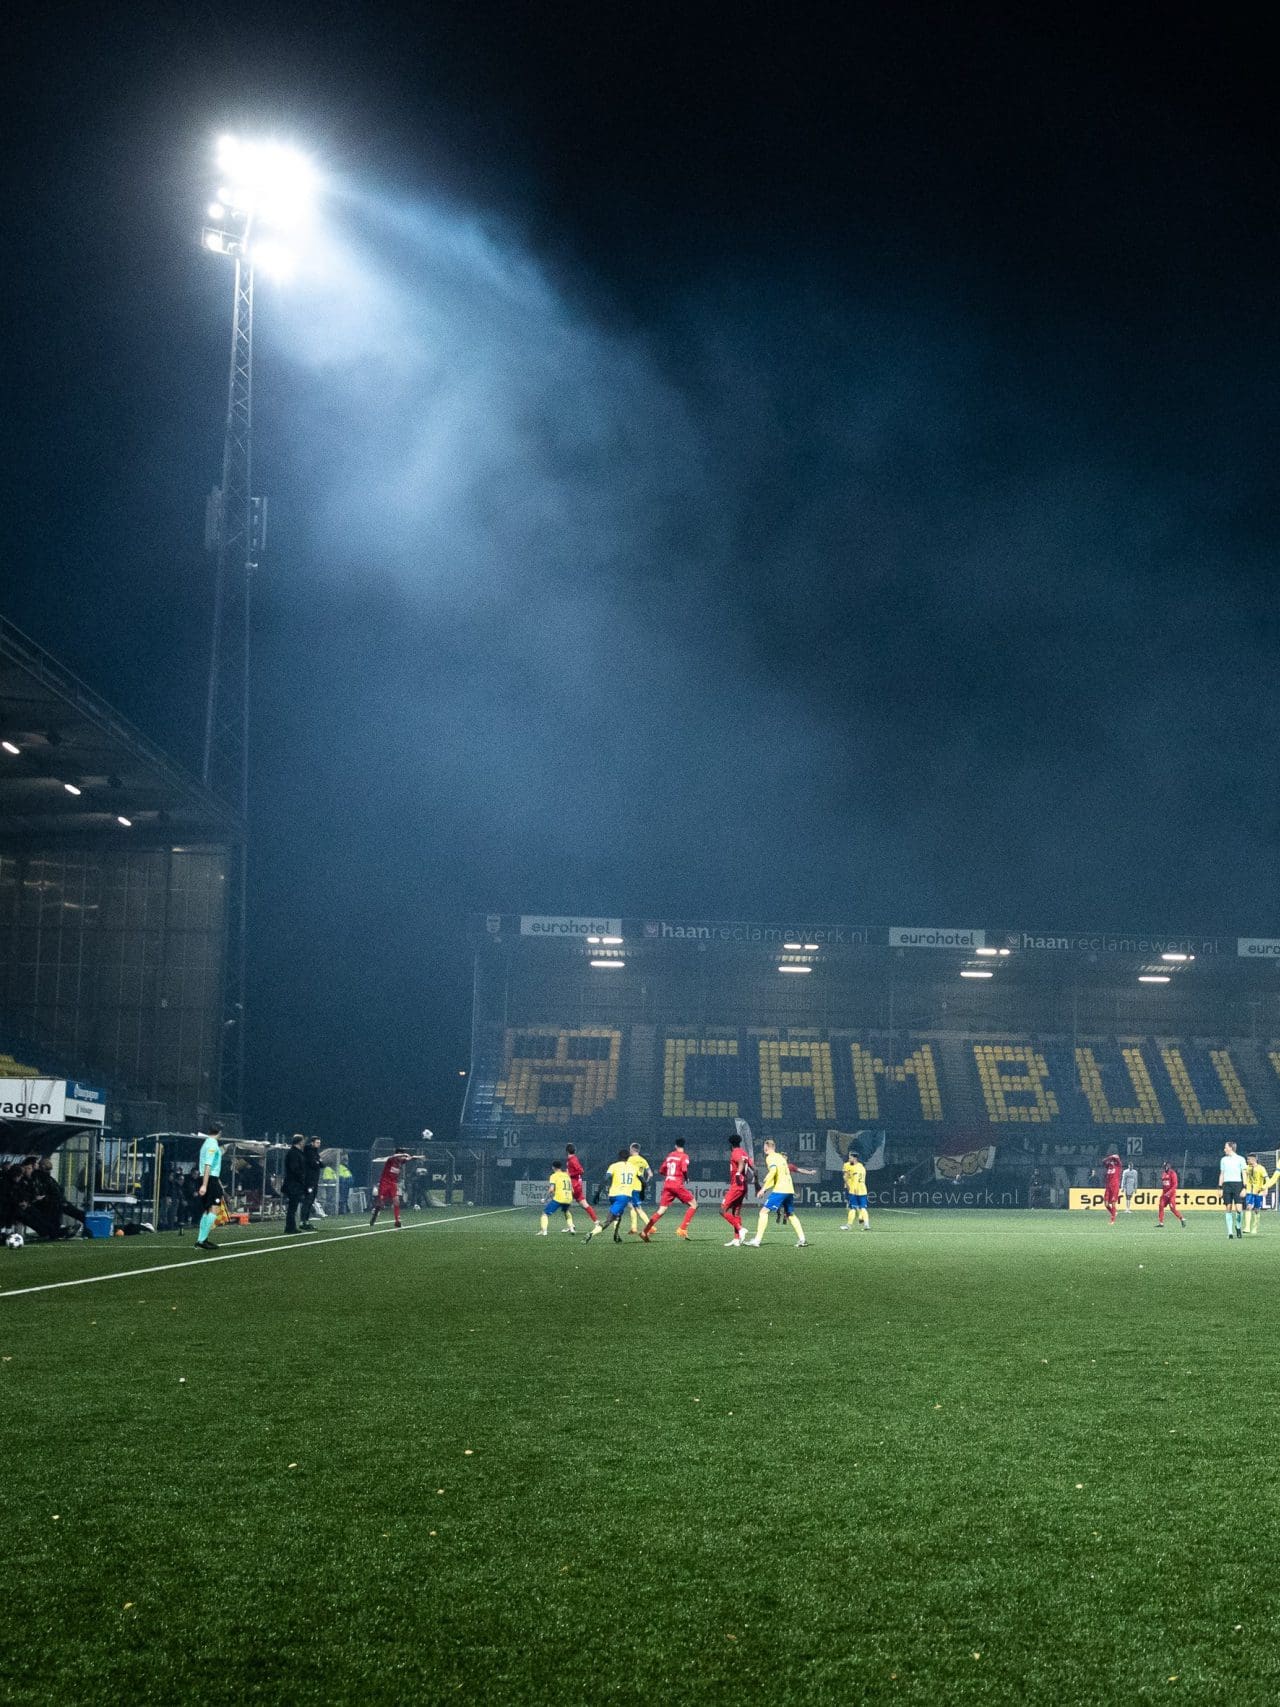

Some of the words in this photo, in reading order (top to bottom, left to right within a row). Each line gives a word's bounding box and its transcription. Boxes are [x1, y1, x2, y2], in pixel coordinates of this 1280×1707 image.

[531, 921, 611, 936] eurohotel
[899, 932, 975, 946] eurohotel
[0, 1102, 51, 1118] agen
[801, 1133, 815, 1150] 11
[1128, 1138, 1142, 1155] 12
[620, 1172, 633, 1185] 16
[806, 1187, 1019, 1205] haaeclamewerk.nl
[1081, 1193, 1227, 1206] sprdirct.co
